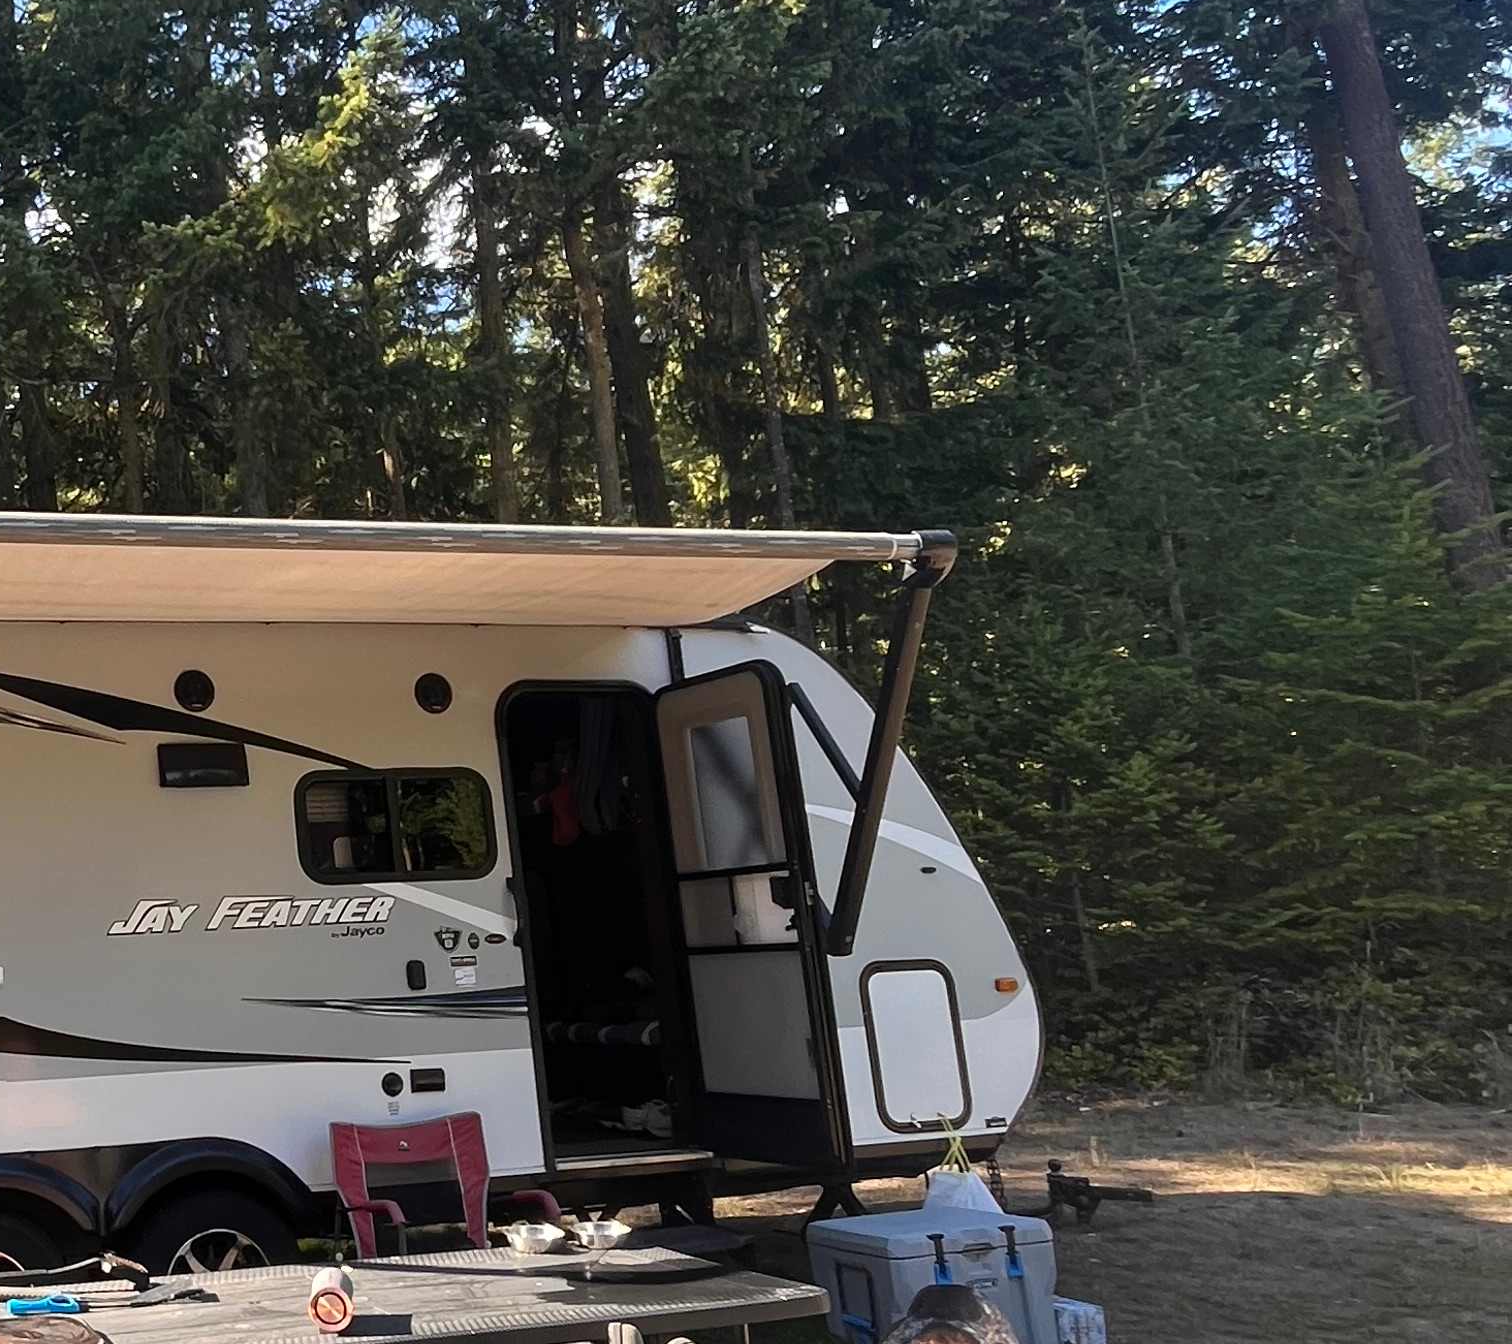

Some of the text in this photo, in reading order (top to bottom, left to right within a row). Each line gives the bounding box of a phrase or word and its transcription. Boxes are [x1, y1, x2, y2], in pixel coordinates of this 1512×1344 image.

[107, 895, 396, 936] JAY FEATHER
[340, 925, 385, 939] Jayco
